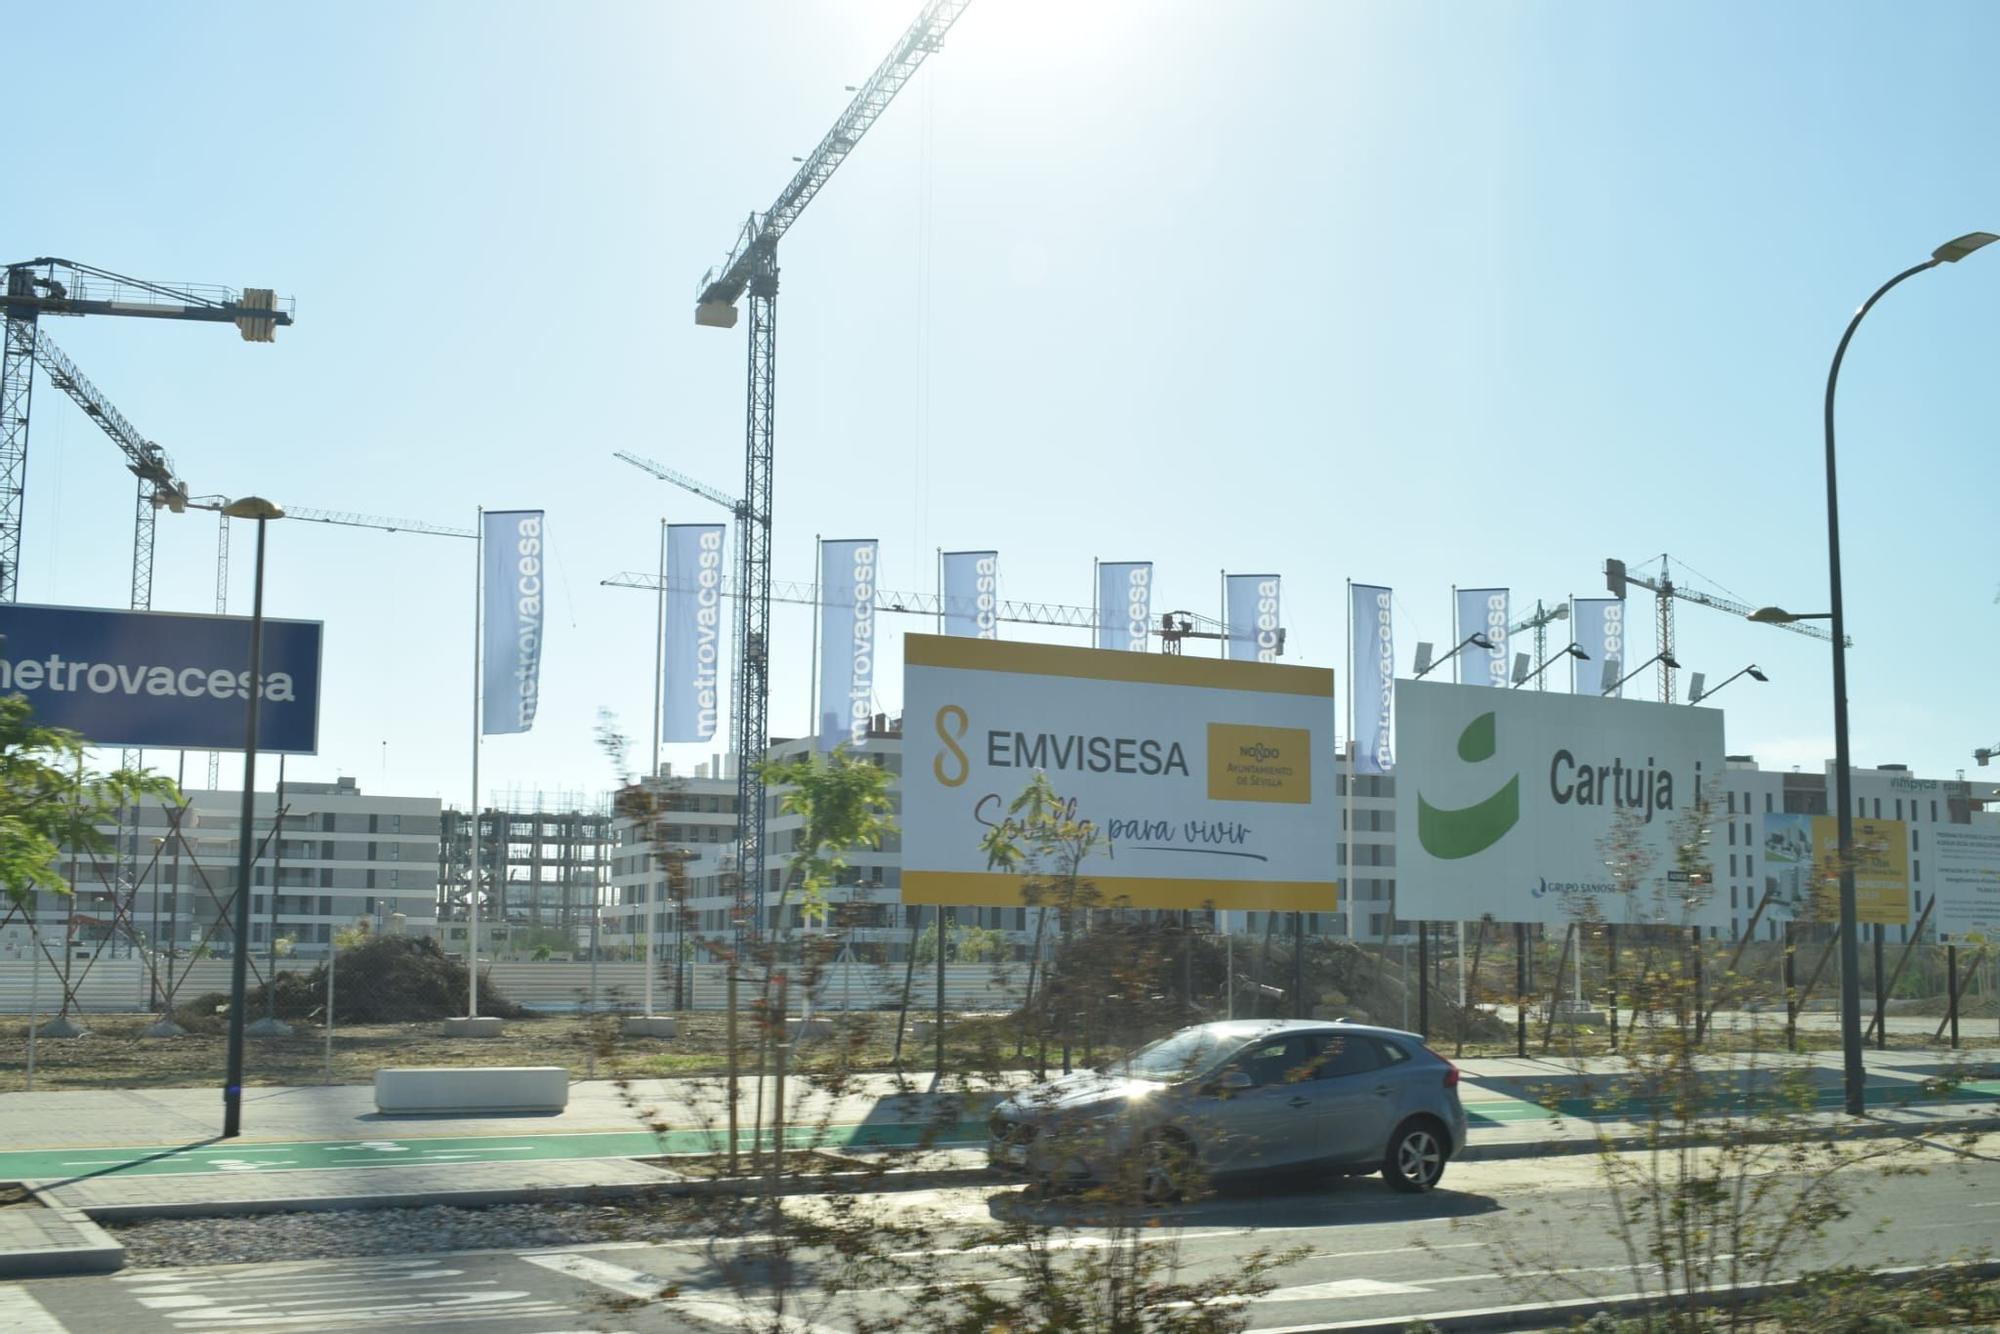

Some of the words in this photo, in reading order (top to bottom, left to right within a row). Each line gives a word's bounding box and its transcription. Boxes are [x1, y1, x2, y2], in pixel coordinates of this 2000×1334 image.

[514, 516, 541, 727] metrovacesa
[693, 530, 721, 738] metrovacesa
[976, 555, 995, 639] acesa
[1129, 566, 1149, 653] acesa
[1258, 579, 1277, 664] acesa
[1603, 604, 1622, 660] esa
[0, 654, 295, 701] etrovacesa
[848, 544, 875, 747] metrovacesa
[1488, 593, 1506, 688] vacesa
[986, 729, 1190, 777] EMVISESA
[1550, 748, 1674, 824] Cartuja
[1107, 816, 1176, 860] para
[1183, 818, 1253, 845] vivir
